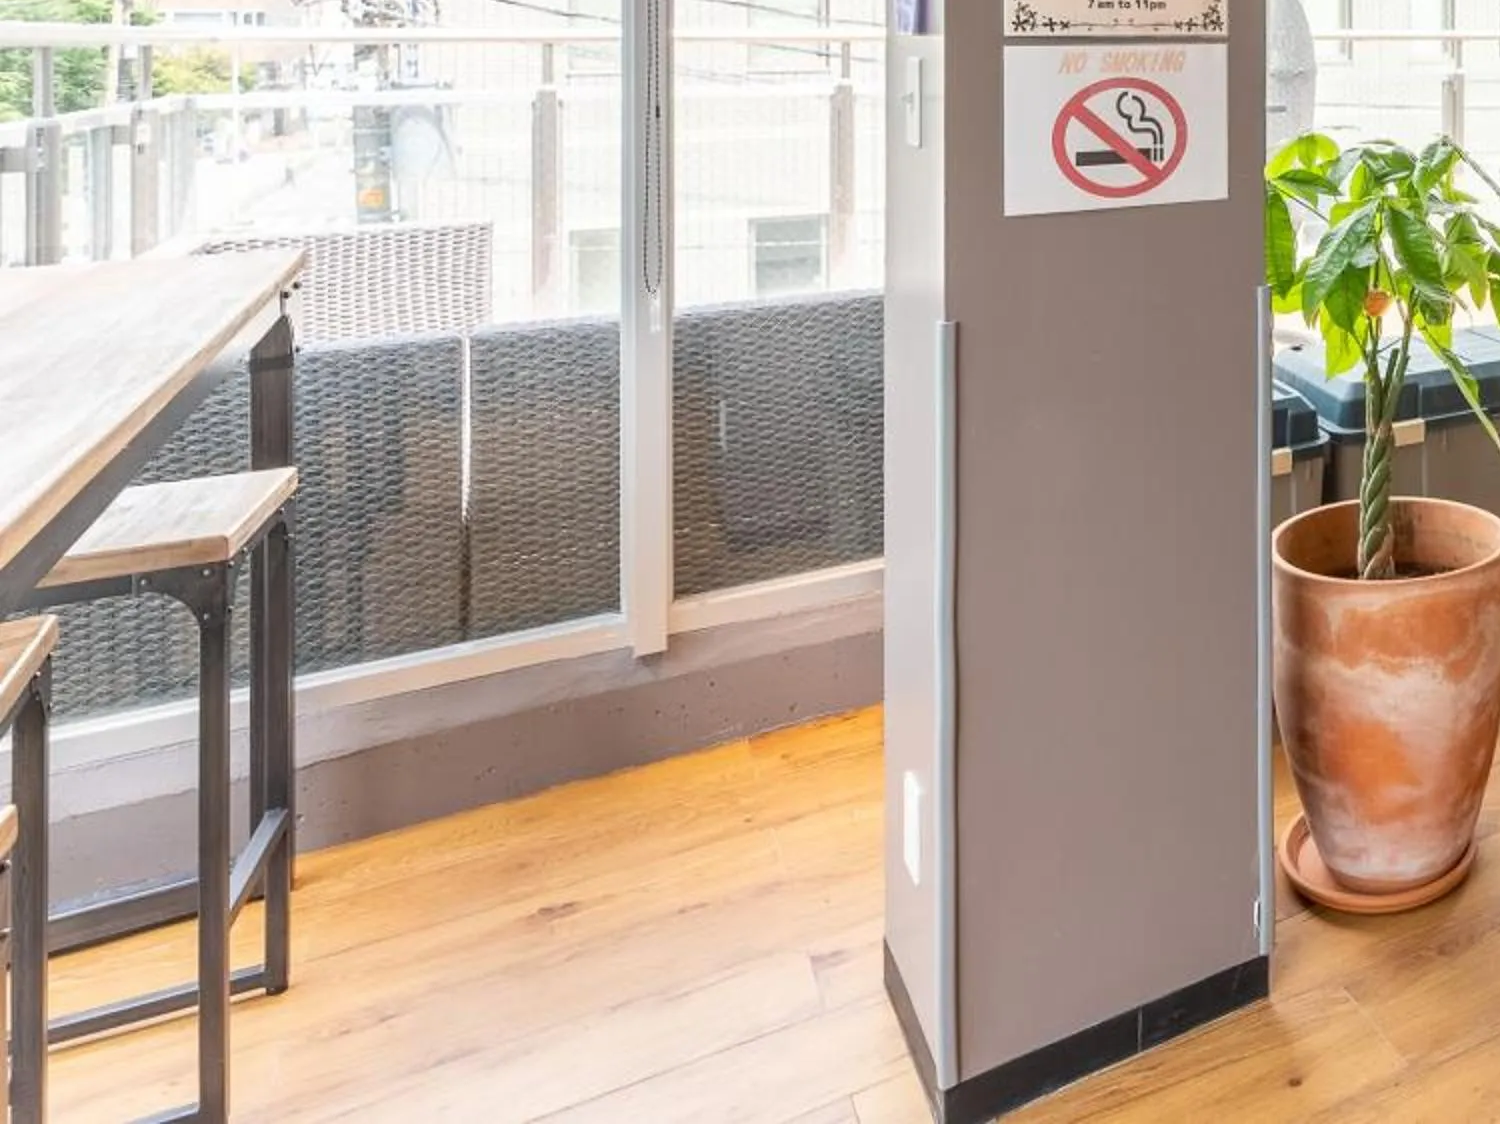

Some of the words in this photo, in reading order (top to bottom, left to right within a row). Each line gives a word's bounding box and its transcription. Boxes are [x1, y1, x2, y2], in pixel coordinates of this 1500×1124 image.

[1118, 0, 1131, 9] to
[1135, 0, 1167, 11] 11pm
[1057, 50, 1088, 74] NO
[1099, 50, 1187, 74] SMOKING
